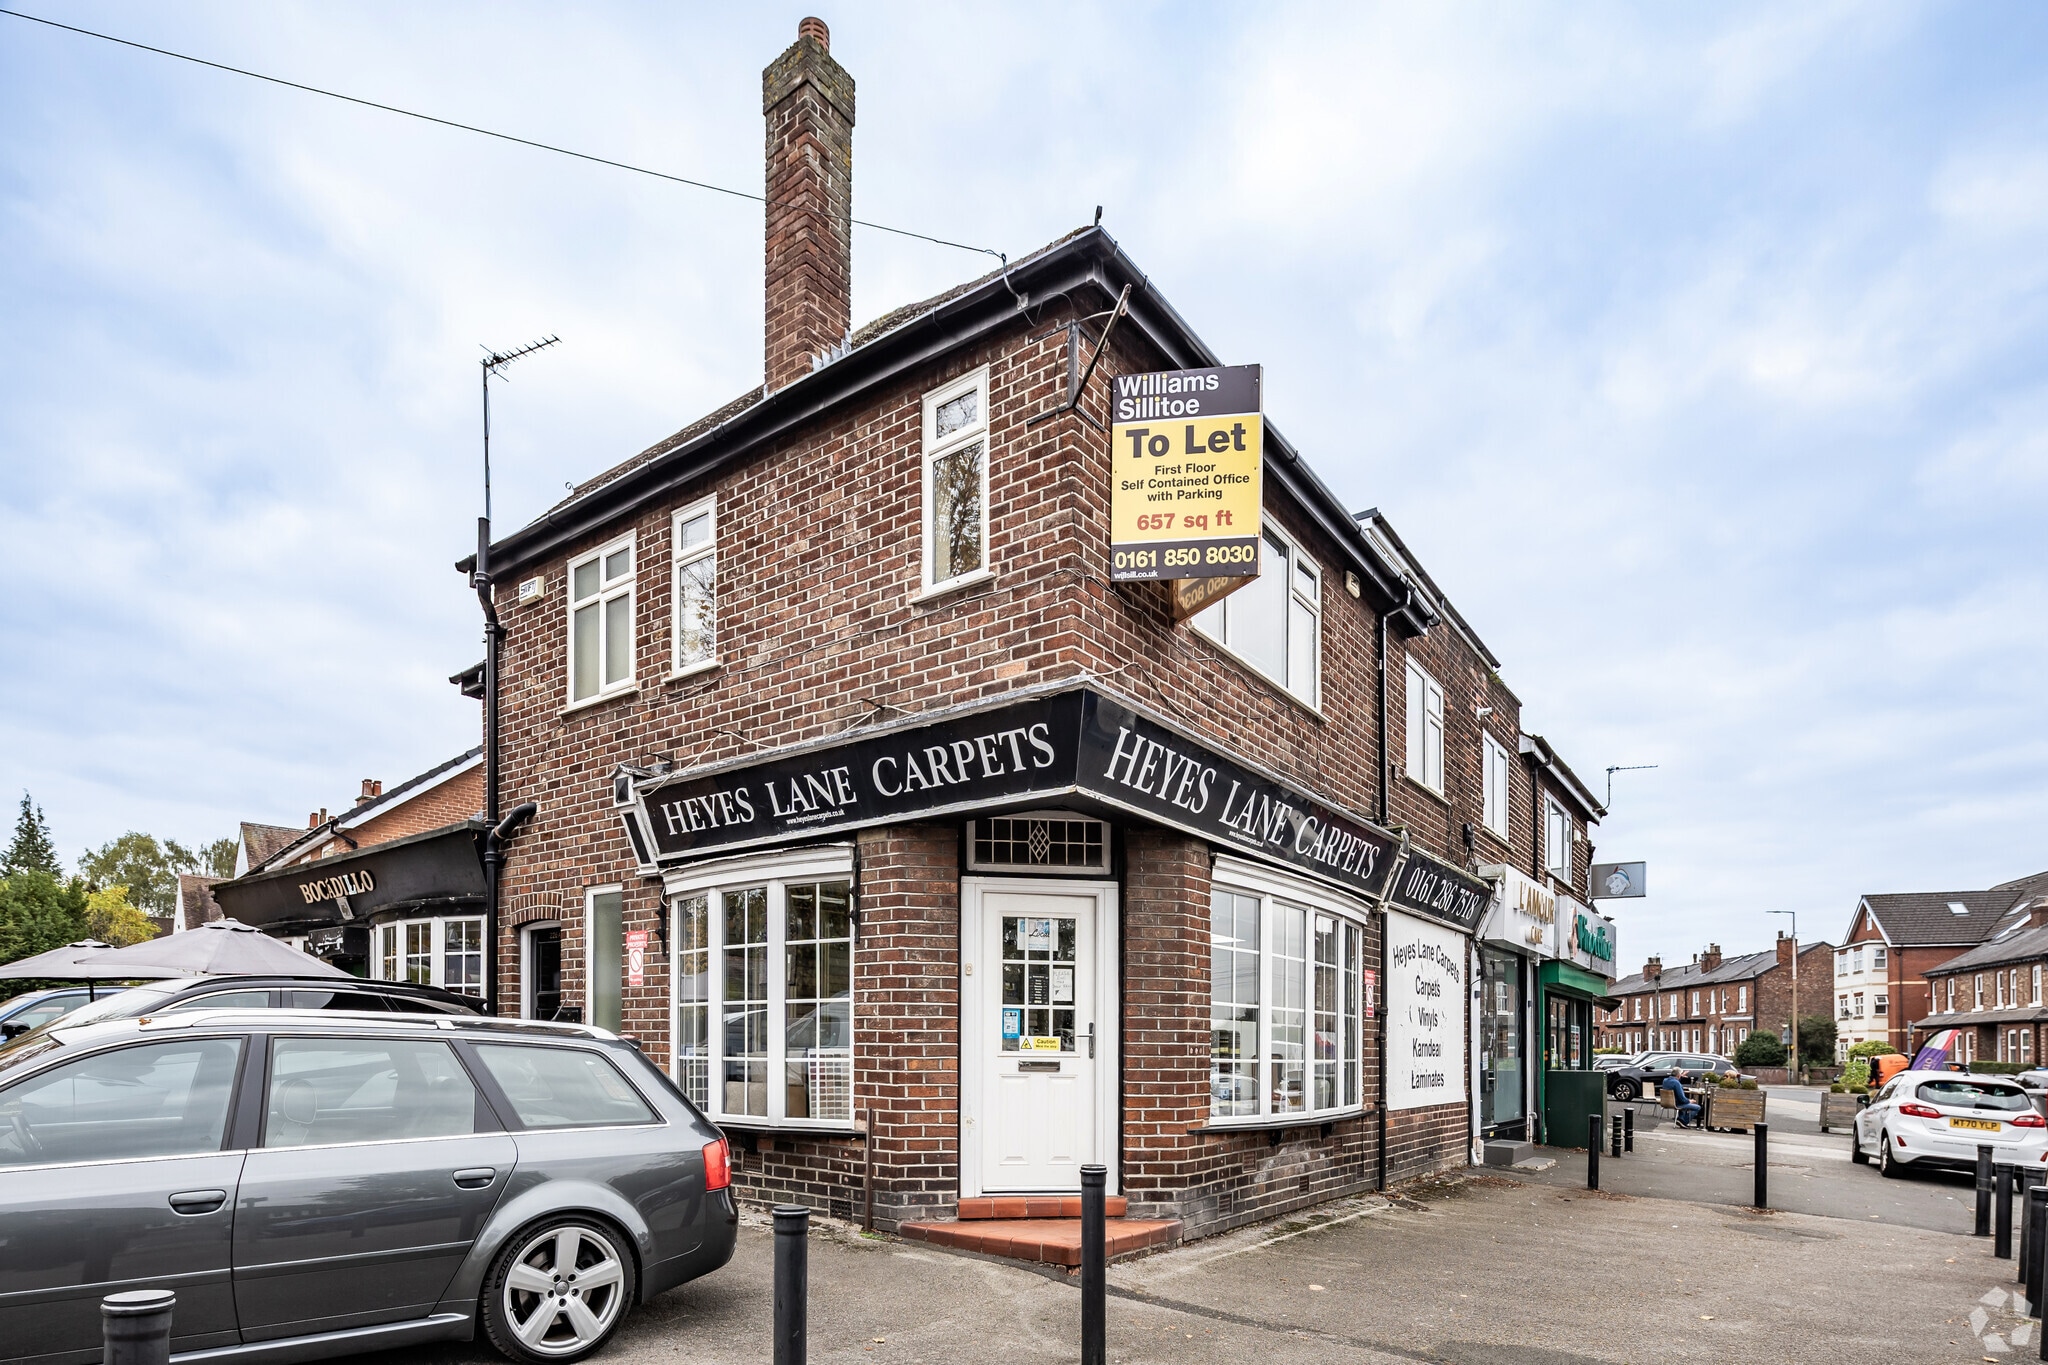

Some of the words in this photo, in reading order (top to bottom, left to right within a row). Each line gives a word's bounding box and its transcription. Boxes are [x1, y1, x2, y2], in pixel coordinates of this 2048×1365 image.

[1118, 373, 1220, 397] Williams
[1118, 396, 1200, 420] Sillitoe
[1126, 428, 1170, 458] To
[1185, 423, 1246, 455] Let
[1154, 464, 1182, 475] First
[1185, 463, 1216, 474] Floor
[1121, 480, 1144, 490] Self
[1148, 475, 1209, 489] Contained
[1213, 474, 1250, 485] Office
[1147, 491, 1173, 501] with
[1177, 488, 1223, 500] Parking
[1137, 513, 1175, 531] 657
[1183, 514, 1208, 531] sq
[1215, 509, 1233, 526] ft
[1114, 550, 1157, 569] 0161
[1164, 547, 1200, 567] 850
[1205, 544, 1255, 564] 8030
[661, 787, 755, 836] HEYES
[764, 766, 858, 818] LANE
[872, 723, 1056, 797] CARPETS
[1103, 726, 1217, 814] HEYES
[1218, 779, 1293, 846] LANE
[1295, 815, 1381, 881] CARPETS
[1405, 867, 1438, 904] 0161
[1432, 879, 1458, 911] 286
[1451, 887, 1479, 920] 7518
[1393, 943, 1416, 968] Heyes
[1417, 938, 1435, 962] Lane
[1436, 944, 1460, 984] Carpets
[1415, 975, 1441, 1001] Carpets
[1418, 1006, 1438, 1031] Vinyls
[1412, 1070, 1444, 1090] Laminates
[1980, 1121, 1997, 1130] YLP
